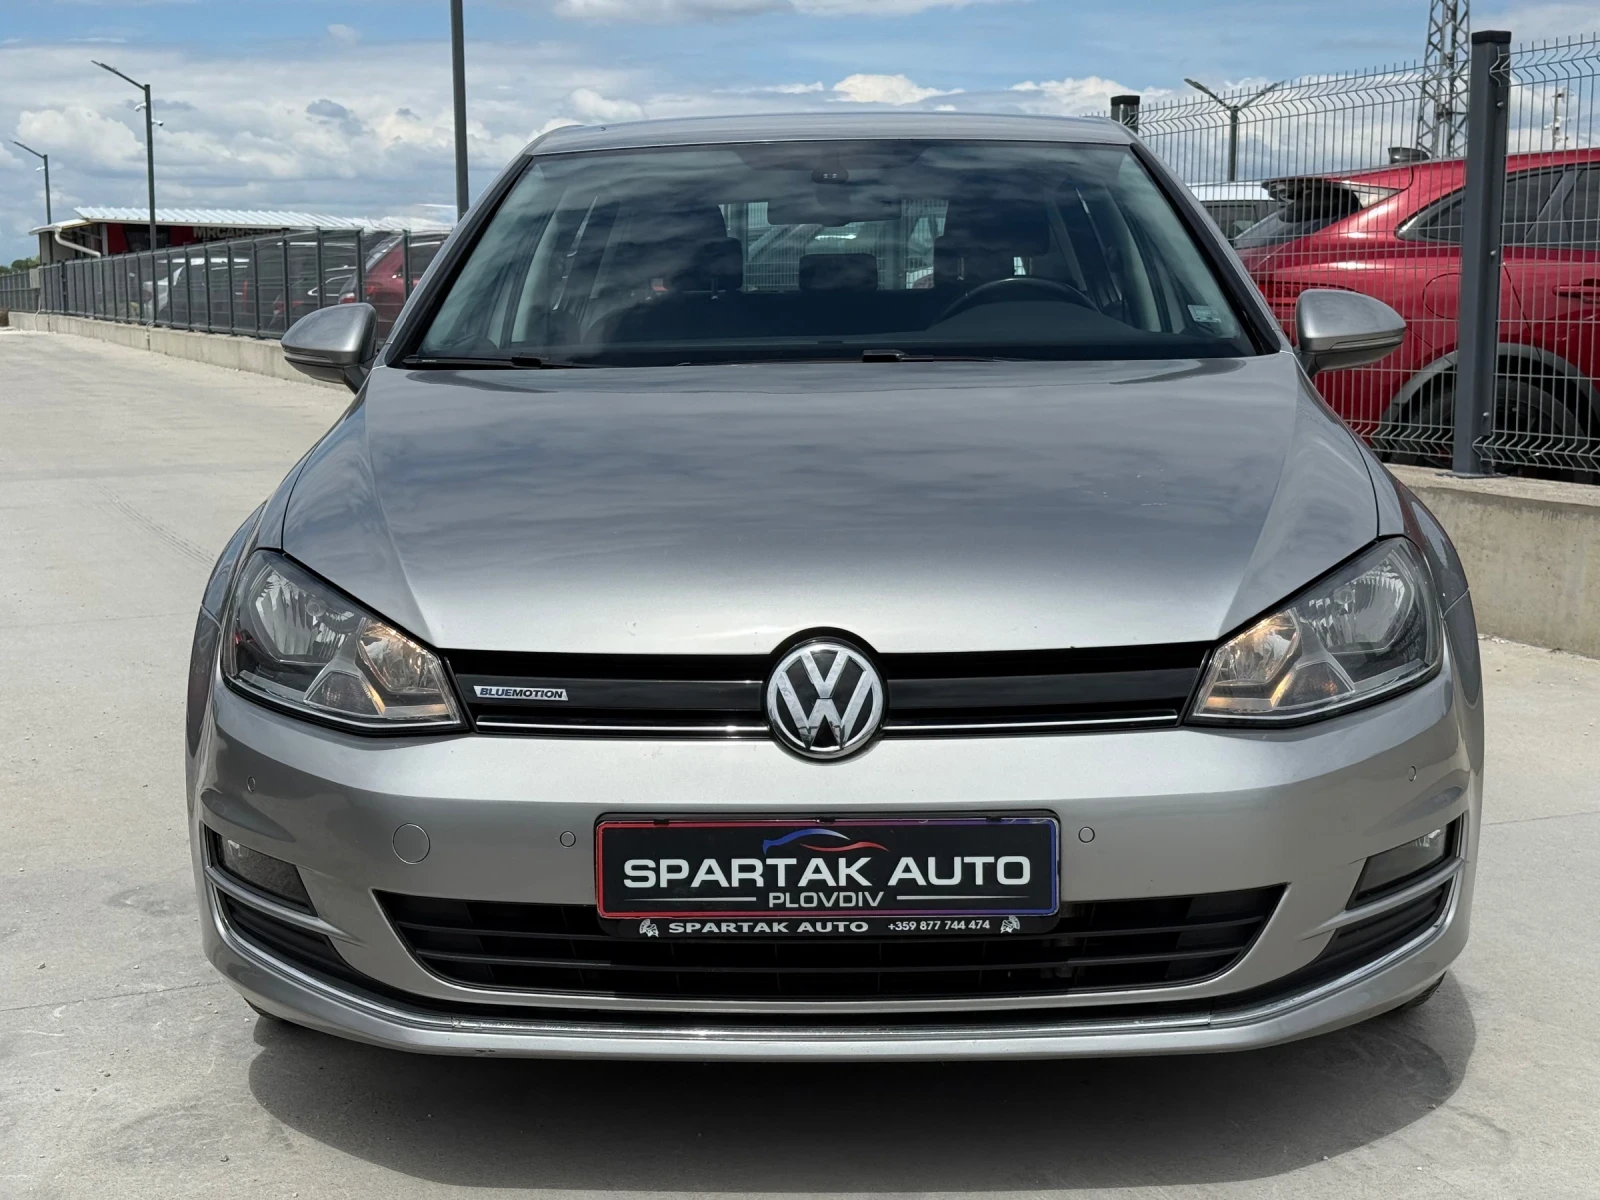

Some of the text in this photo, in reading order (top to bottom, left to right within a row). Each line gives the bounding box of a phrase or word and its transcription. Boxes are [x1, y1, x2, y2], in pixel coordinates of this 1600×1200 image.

[480, 687, 564, 699] BLUEMOTION
[624, 855, 1031, 888] SPARTAK AUTO
[768, 891, 885, 908] PLOVDIV
[668, 919, 990, 933] SPARTAK AUTO +359 877 744 474
